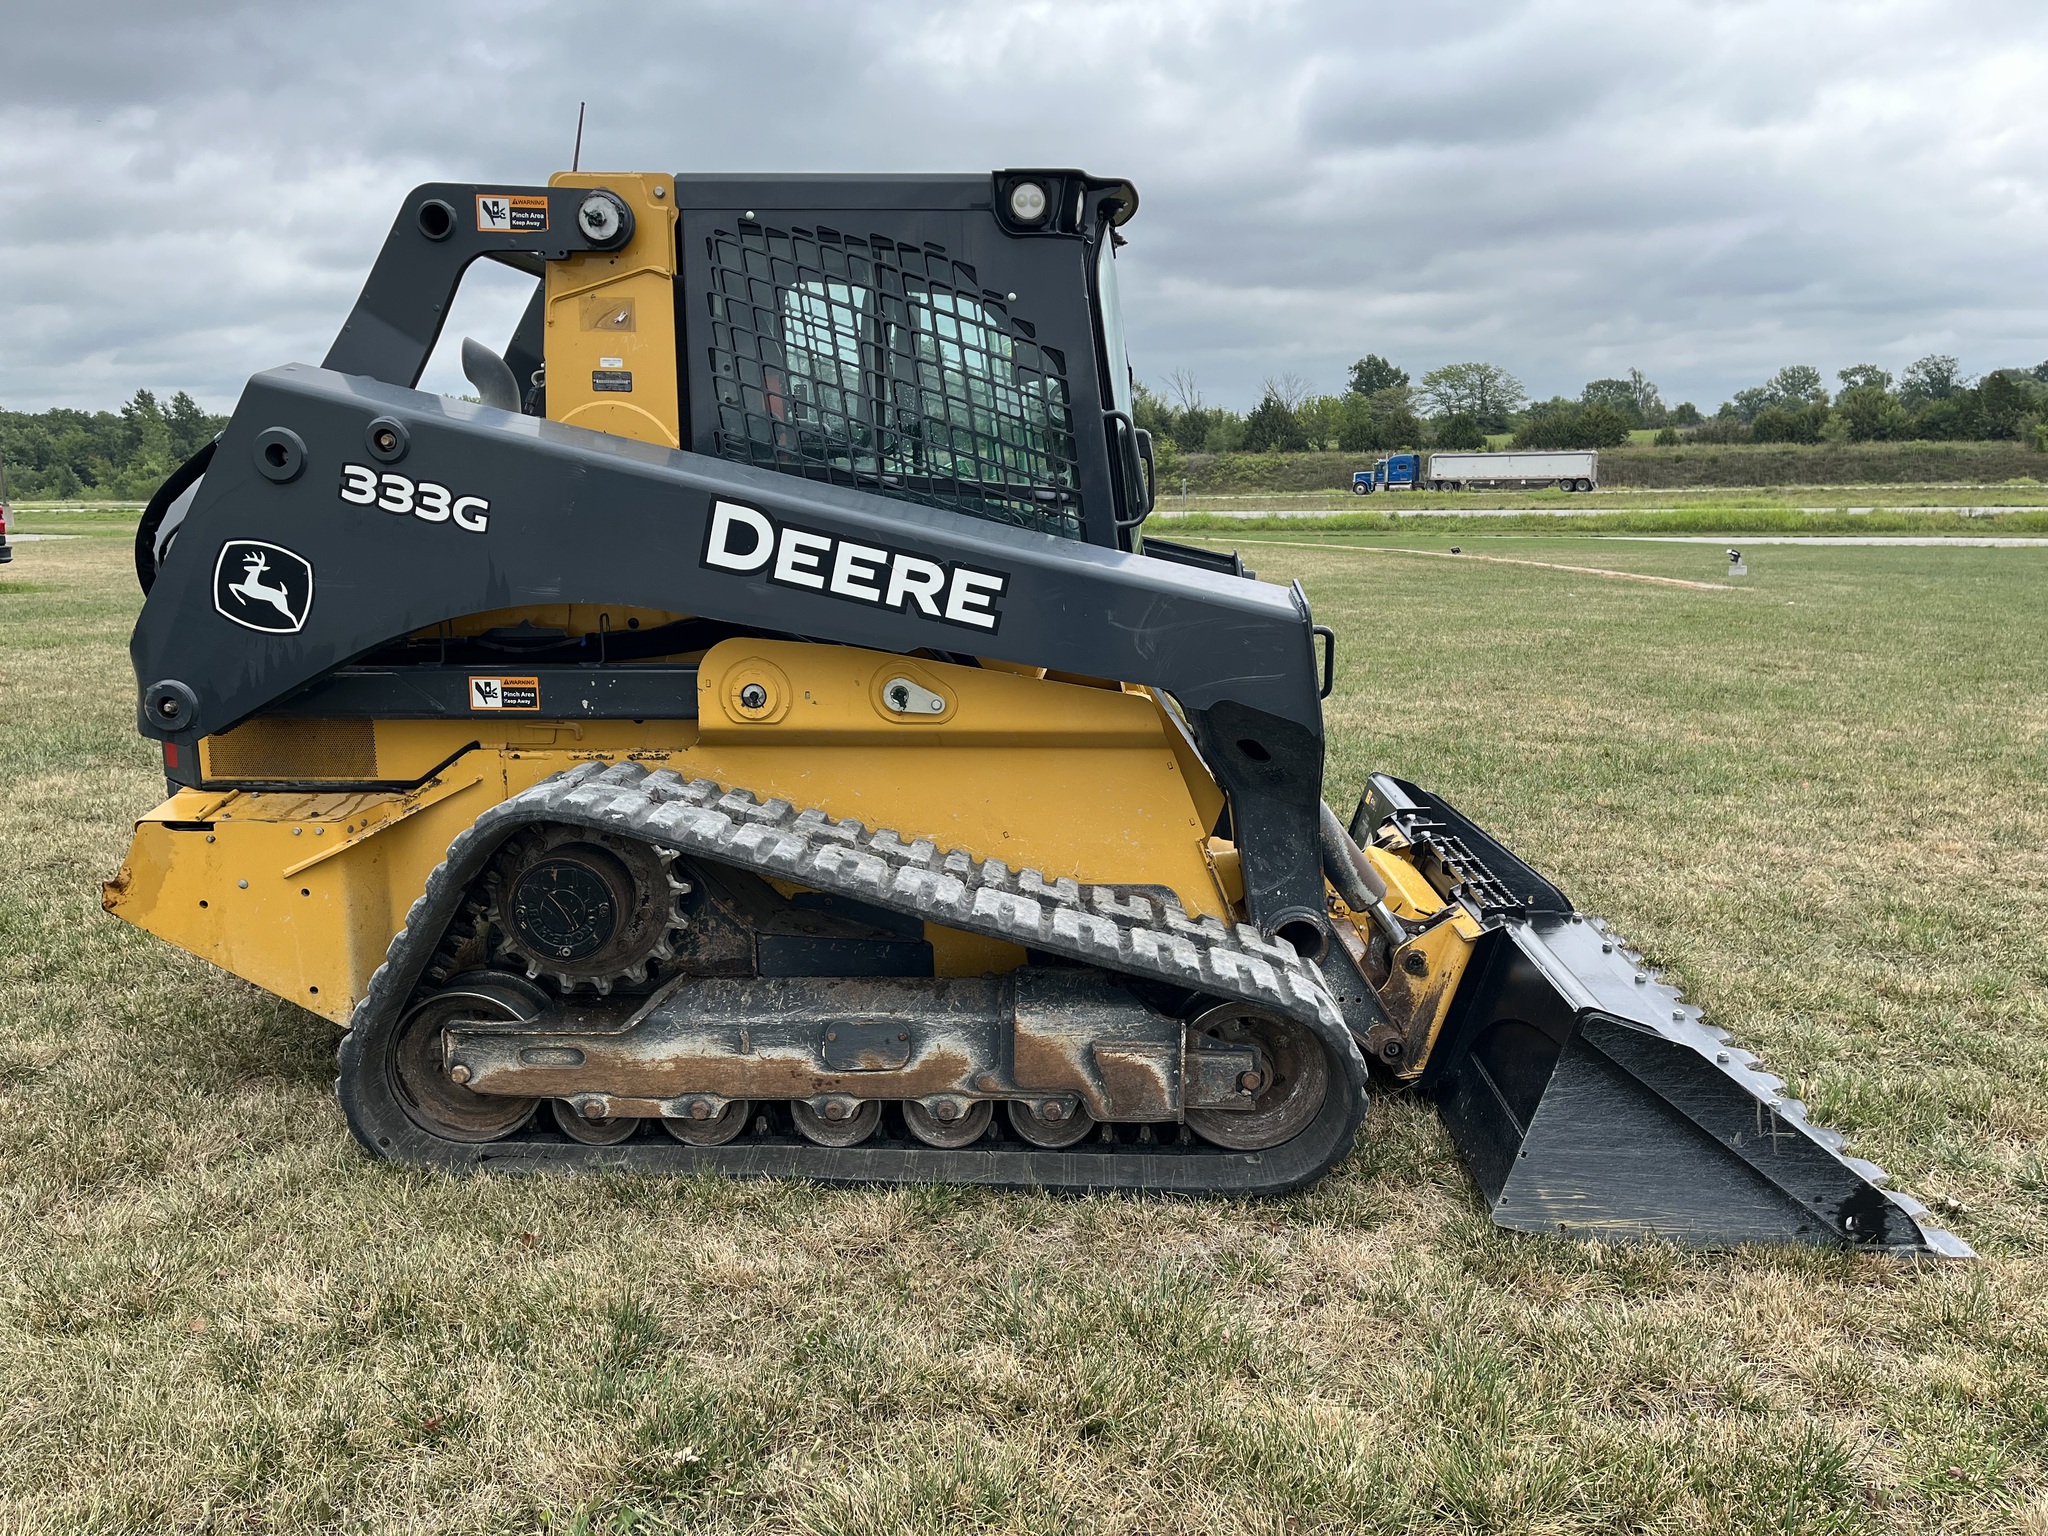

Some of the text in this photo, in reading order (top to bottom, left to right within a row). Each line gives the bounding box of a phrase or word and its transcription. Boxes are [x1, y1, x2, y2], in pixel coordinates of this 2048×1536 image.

[512, 219, 526, 227] Keep
[341, 464, 489, 532] 333G
[706, 500, 1003, 628] DEERE
